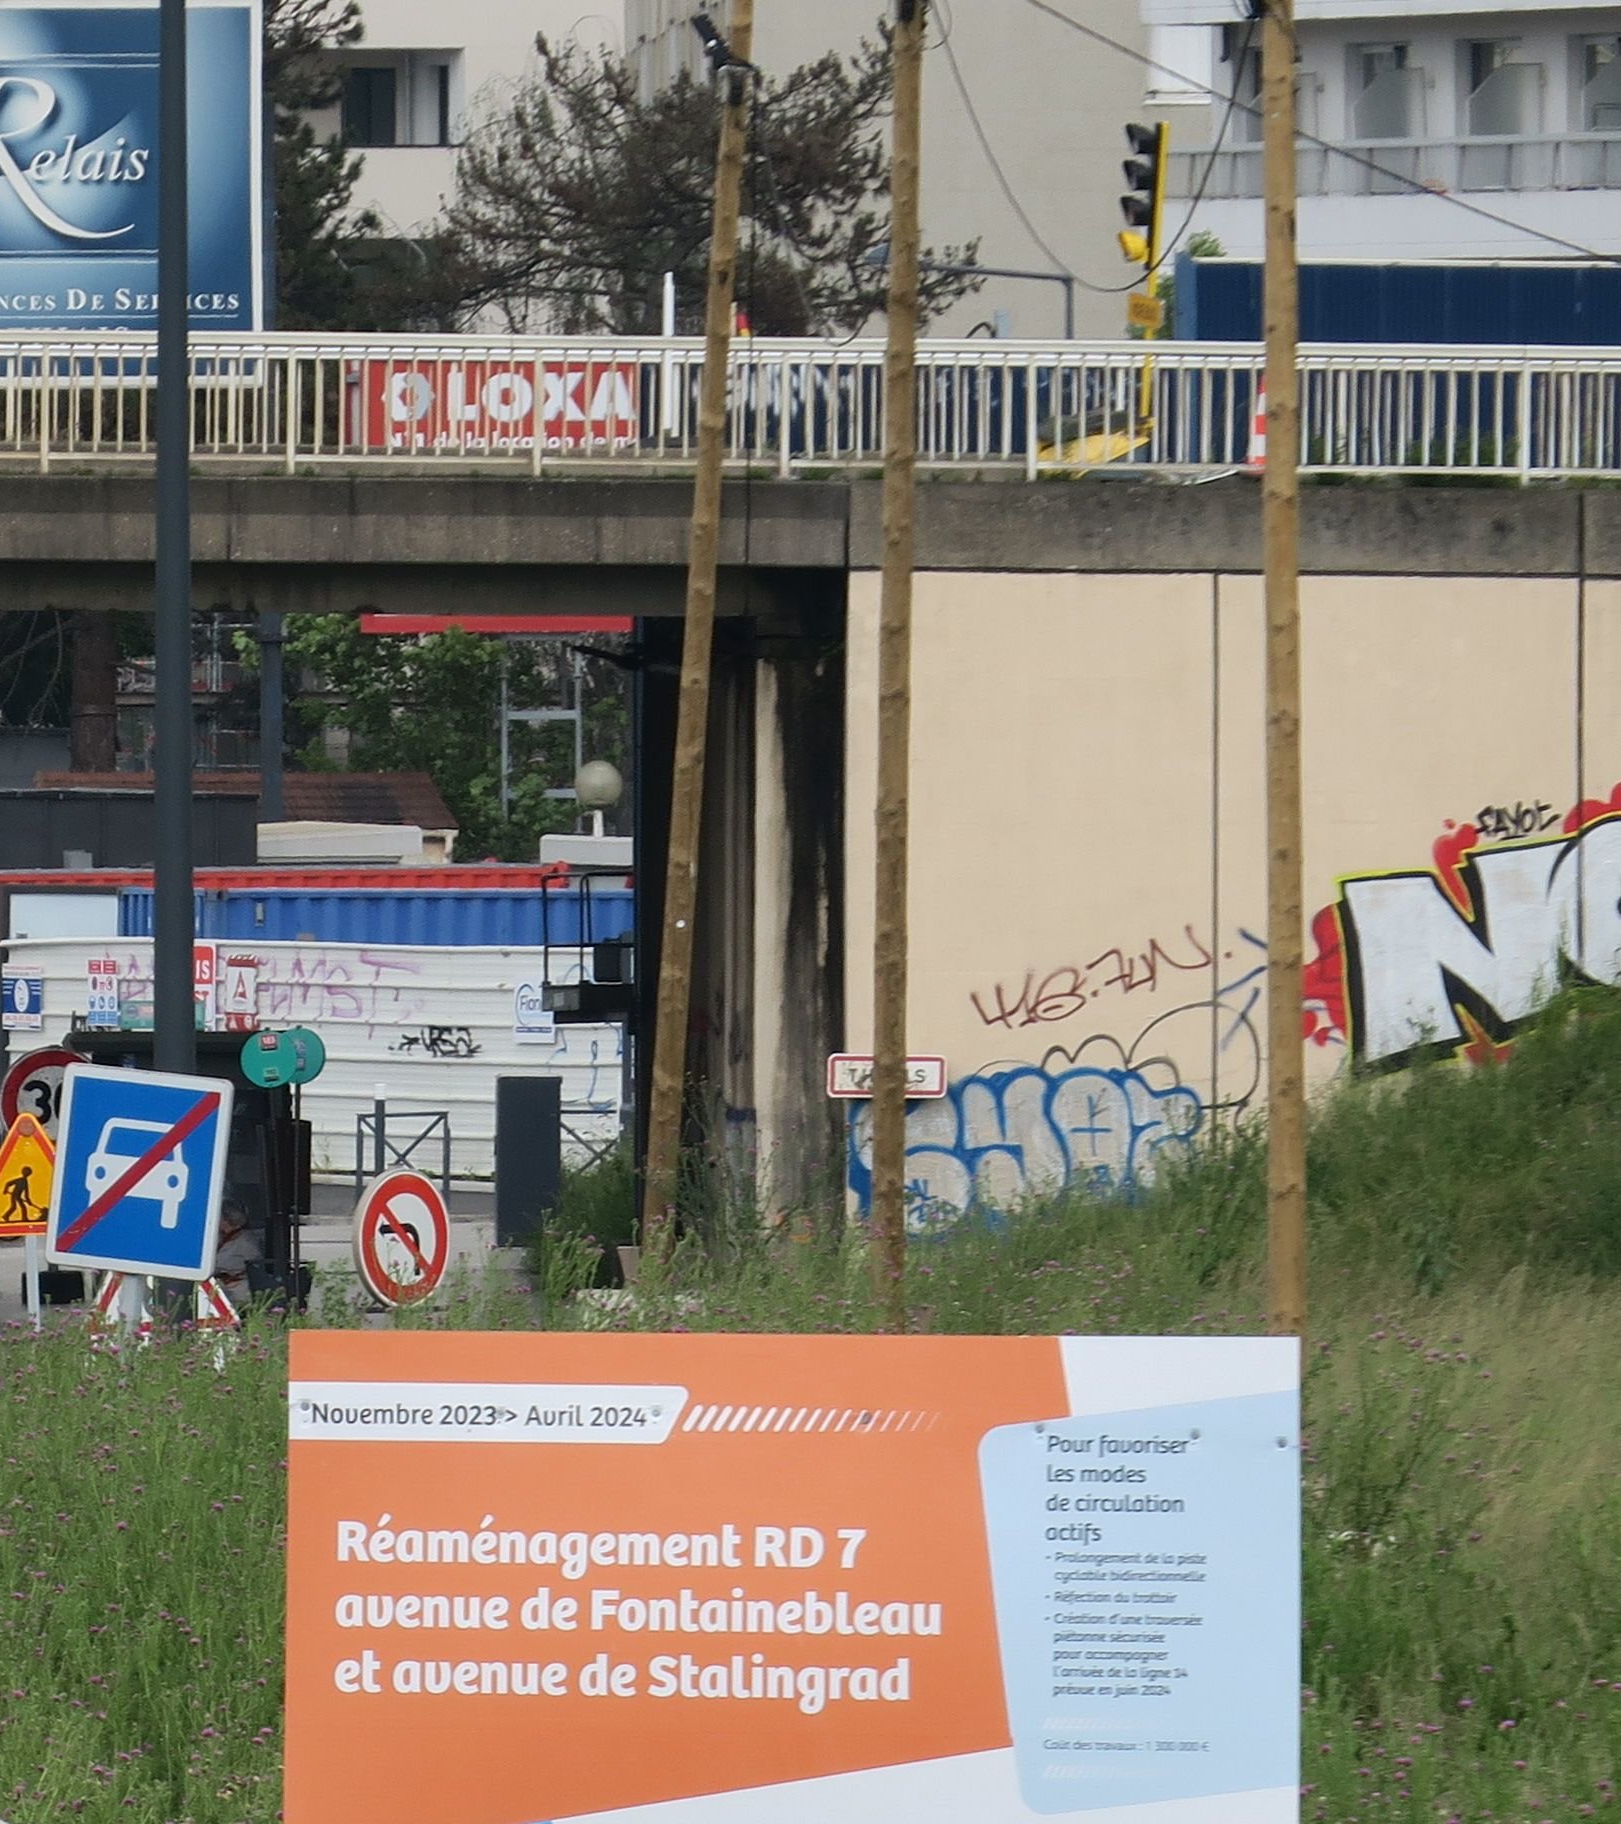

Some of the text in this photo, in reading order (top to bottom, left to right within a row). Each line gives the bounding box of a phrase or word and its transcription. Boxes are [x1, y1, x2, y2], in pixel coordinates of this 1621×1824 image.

[311, 1402, 433, 1427] Novembre
[439, 1404, 498, 1427] 2023
[524, 1403, 586, 1428] Avril
[589, 1405, 647, 1430] 2024
[1047, 1434, 1190, 1458] Pour favoriser
[1080, 1465, 1147, 1483] modes
[1045, 1493, 1186, 1513] de circulation
[335, 1513, 867, 1580] Réaménagement RD 7
[1045, 1521, 1102, 1546] actifs
[334, 1586, 943, 1638] avenue de Fontainebleau
[333, 1650, 912, 1715] et avenue de Stalingrad
